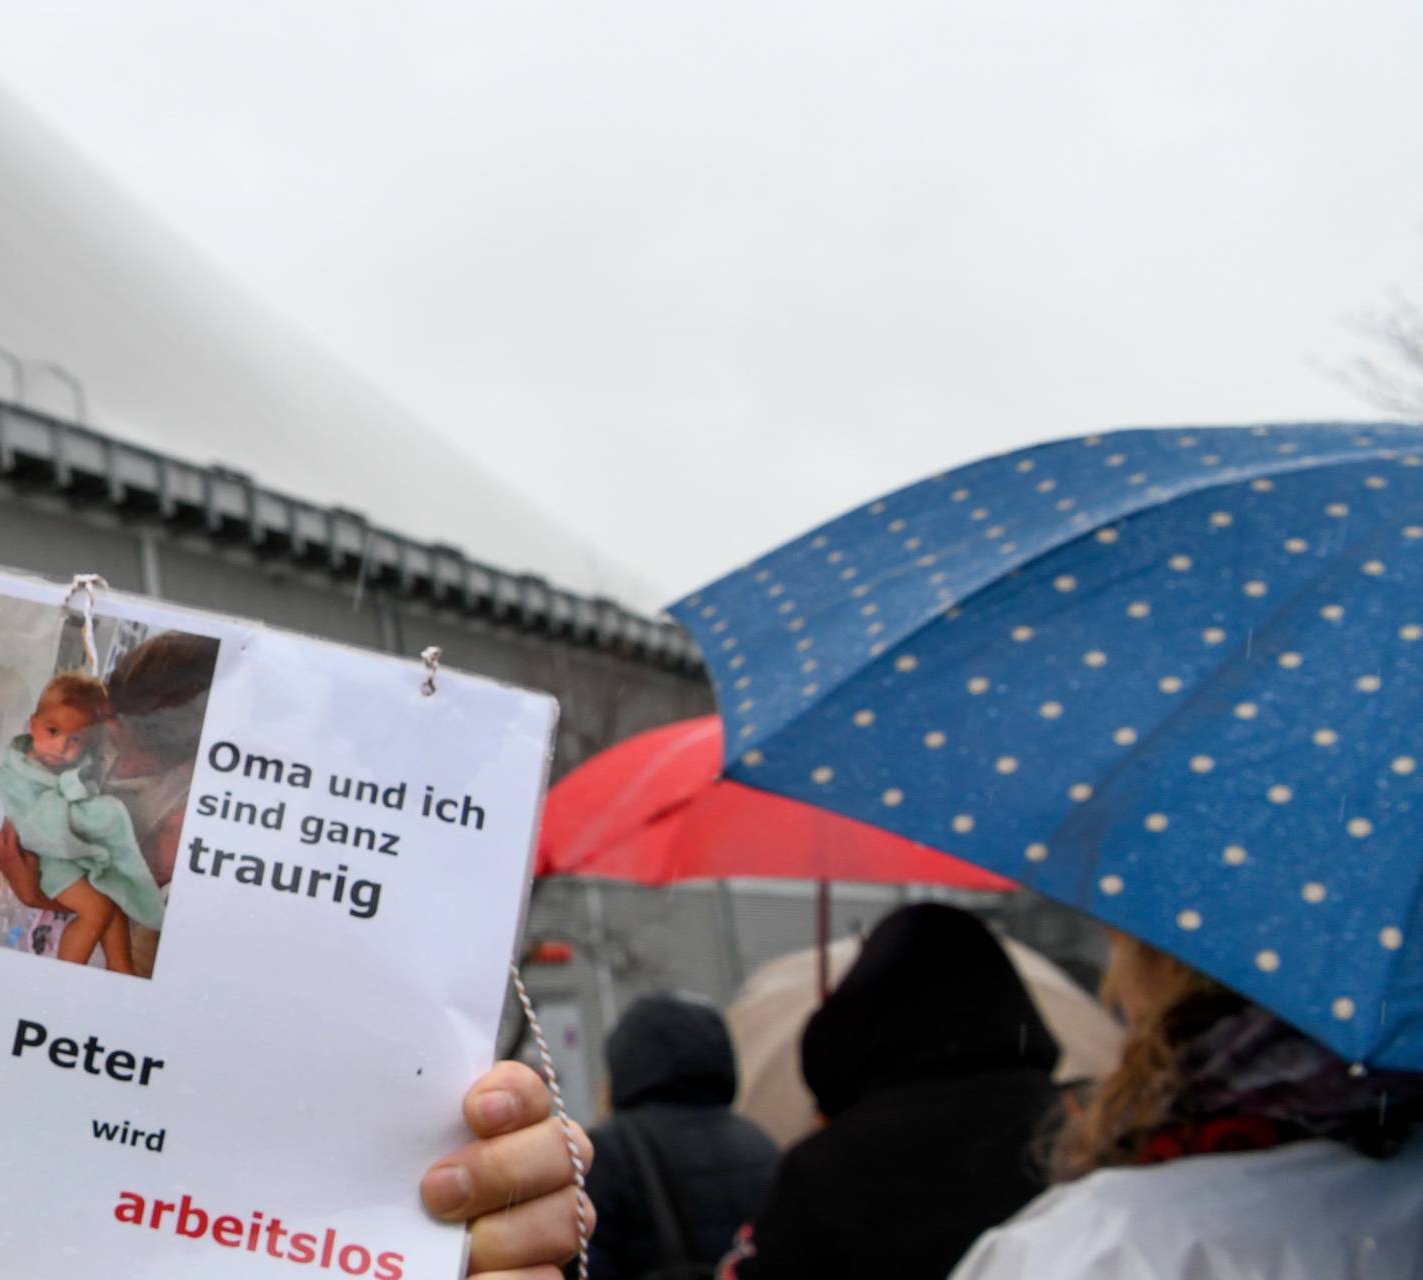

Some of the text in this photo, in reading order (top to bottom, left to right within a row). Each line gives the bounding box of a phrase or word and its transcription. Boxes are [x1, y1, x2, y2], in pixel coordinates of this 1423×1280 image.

[207, 740, 486, 831] Oma und ich
[196, 790, 402, 858] sind ganz
[187, 836, 384, 920] traurig
[10, 1018, 167, 1087] Peter
[91, 1118, 167, 1154] wird
[113, 1189, 406, 1280] arbeitslos
